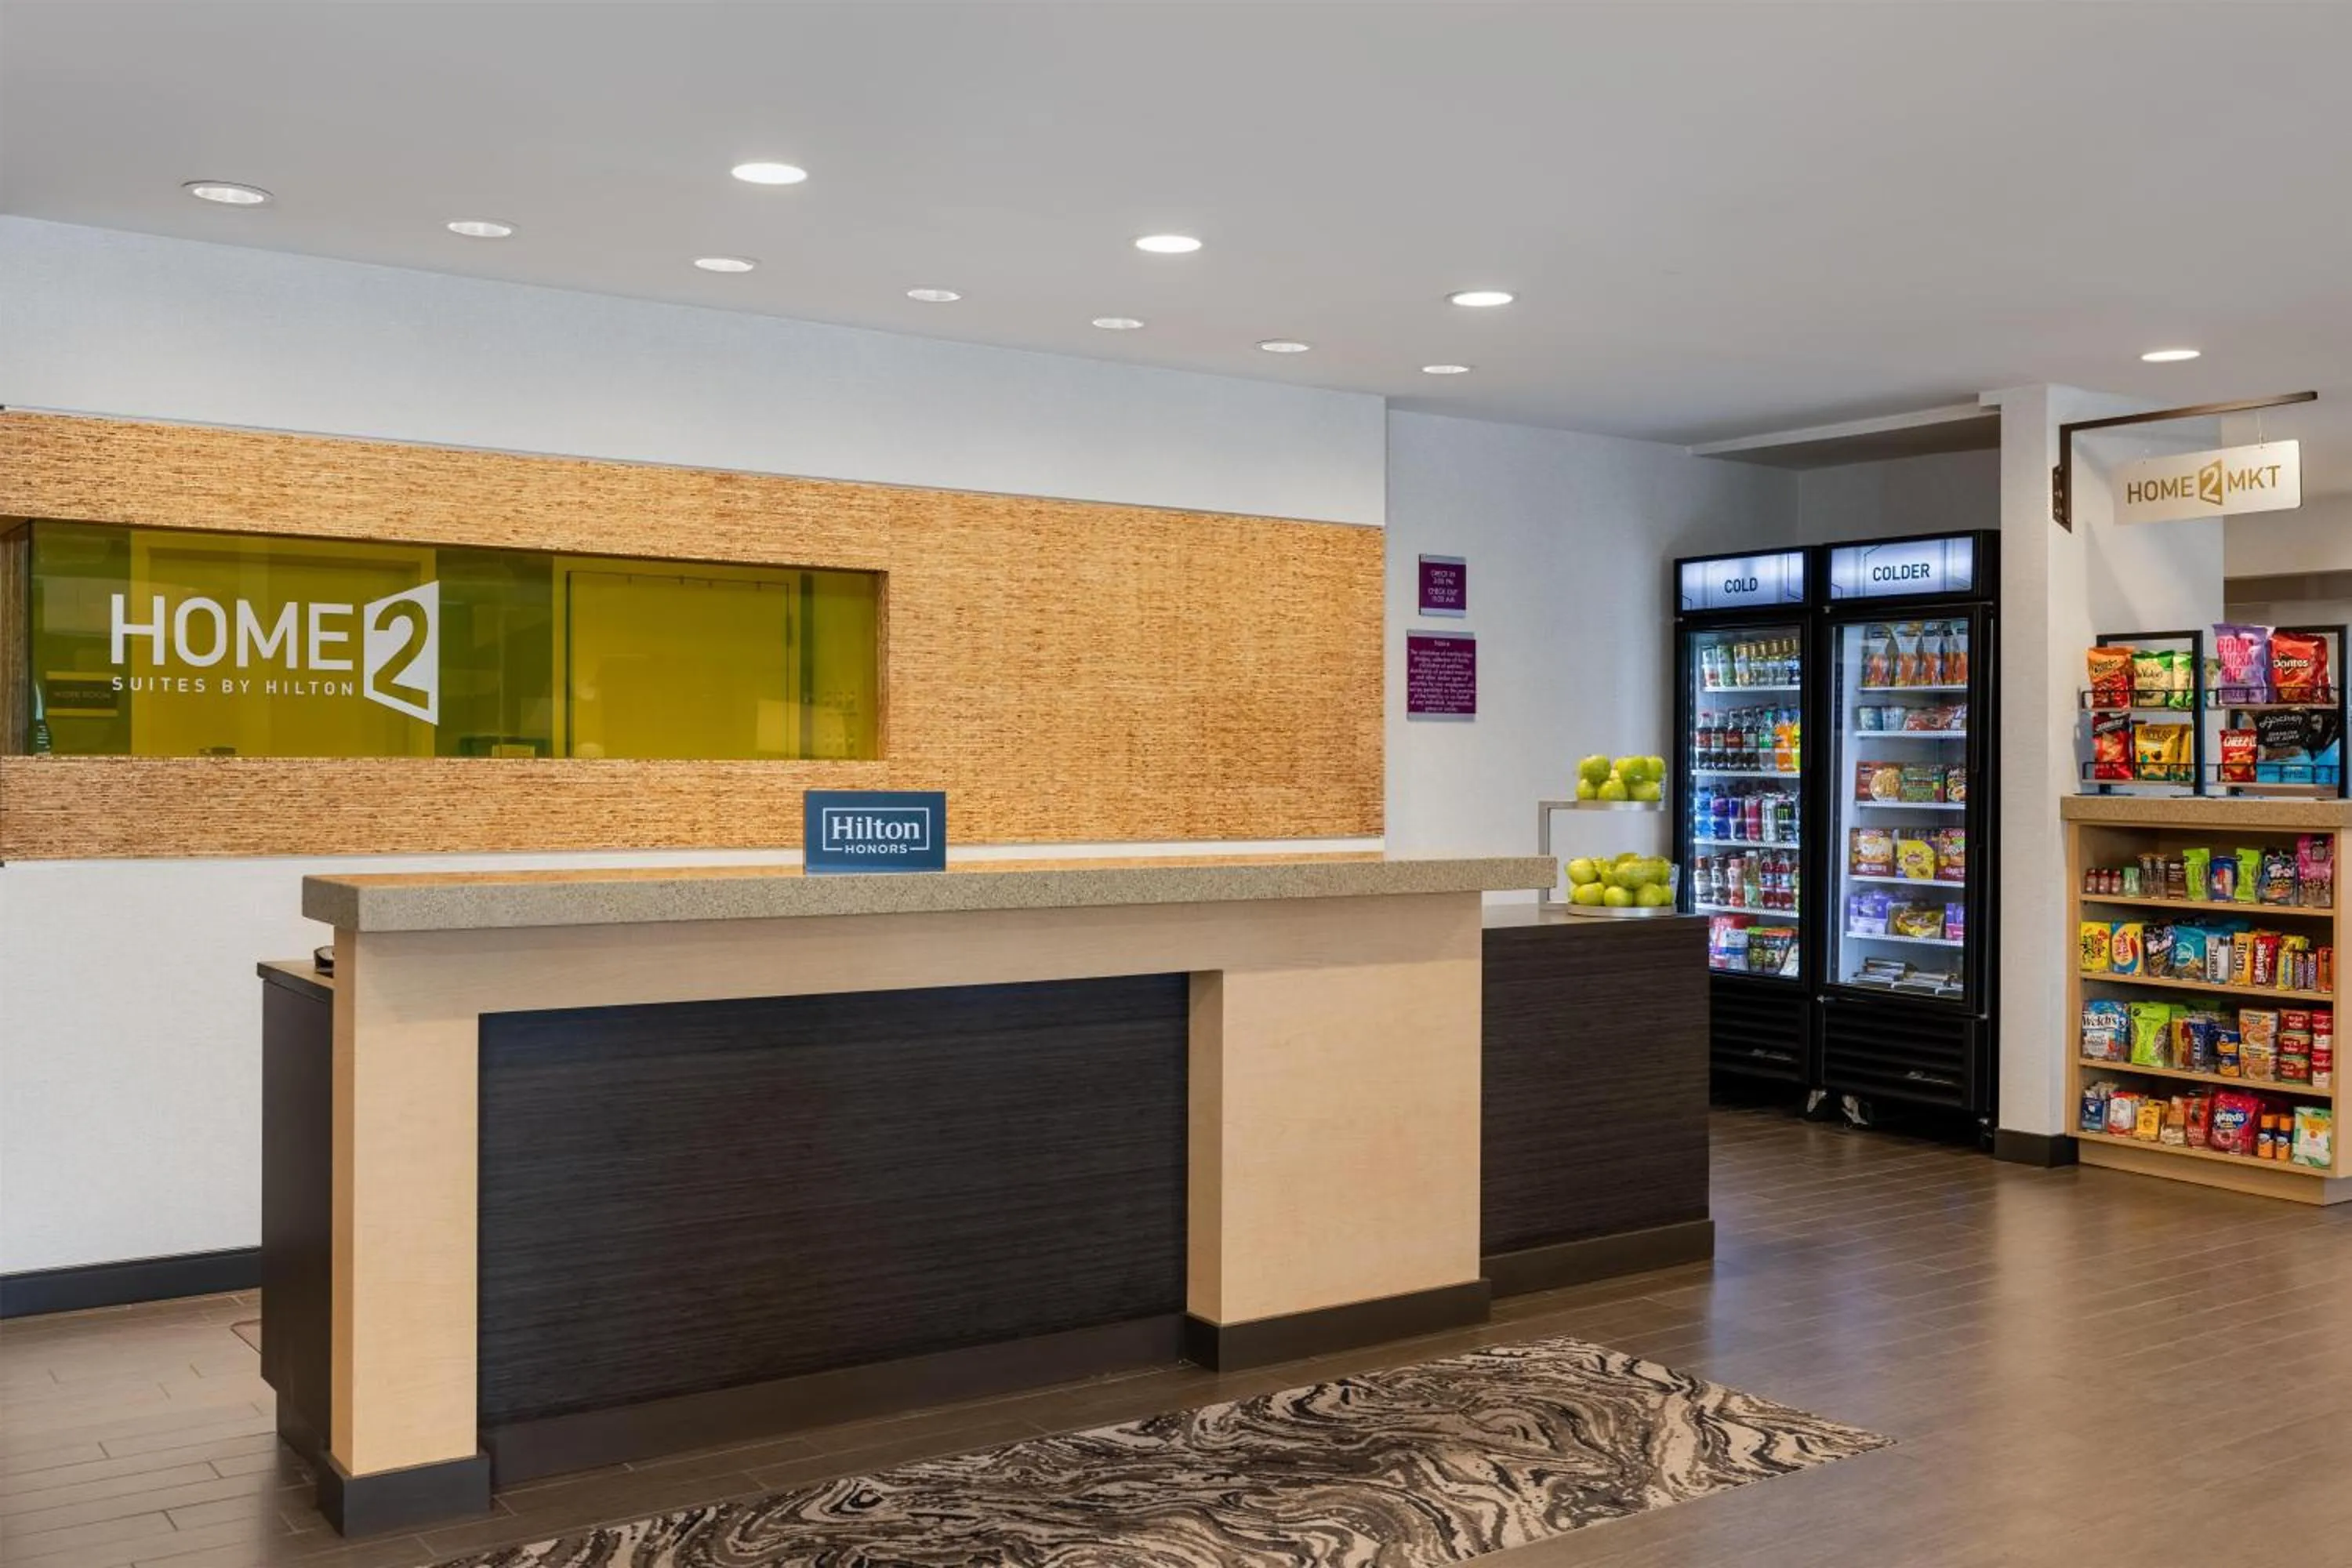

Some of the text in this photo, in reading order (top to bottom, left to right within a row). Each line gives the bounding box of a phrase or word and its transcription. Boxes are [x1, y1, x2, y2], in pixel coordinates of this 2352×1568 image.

[2127, 476, 2194, 504] HOME
[2227, 465, 2281, 493] MKT
[1872, 563, 1930, 582] COLDER
[1724, 577, 1759, 593] COLD
[111, 593, 353, 670] HOME
[112, 677, 354, 696] SUITES BY HILTON
[832, 816, 920, 840] Hilton
[844, 844, 908, 854] HONORS
